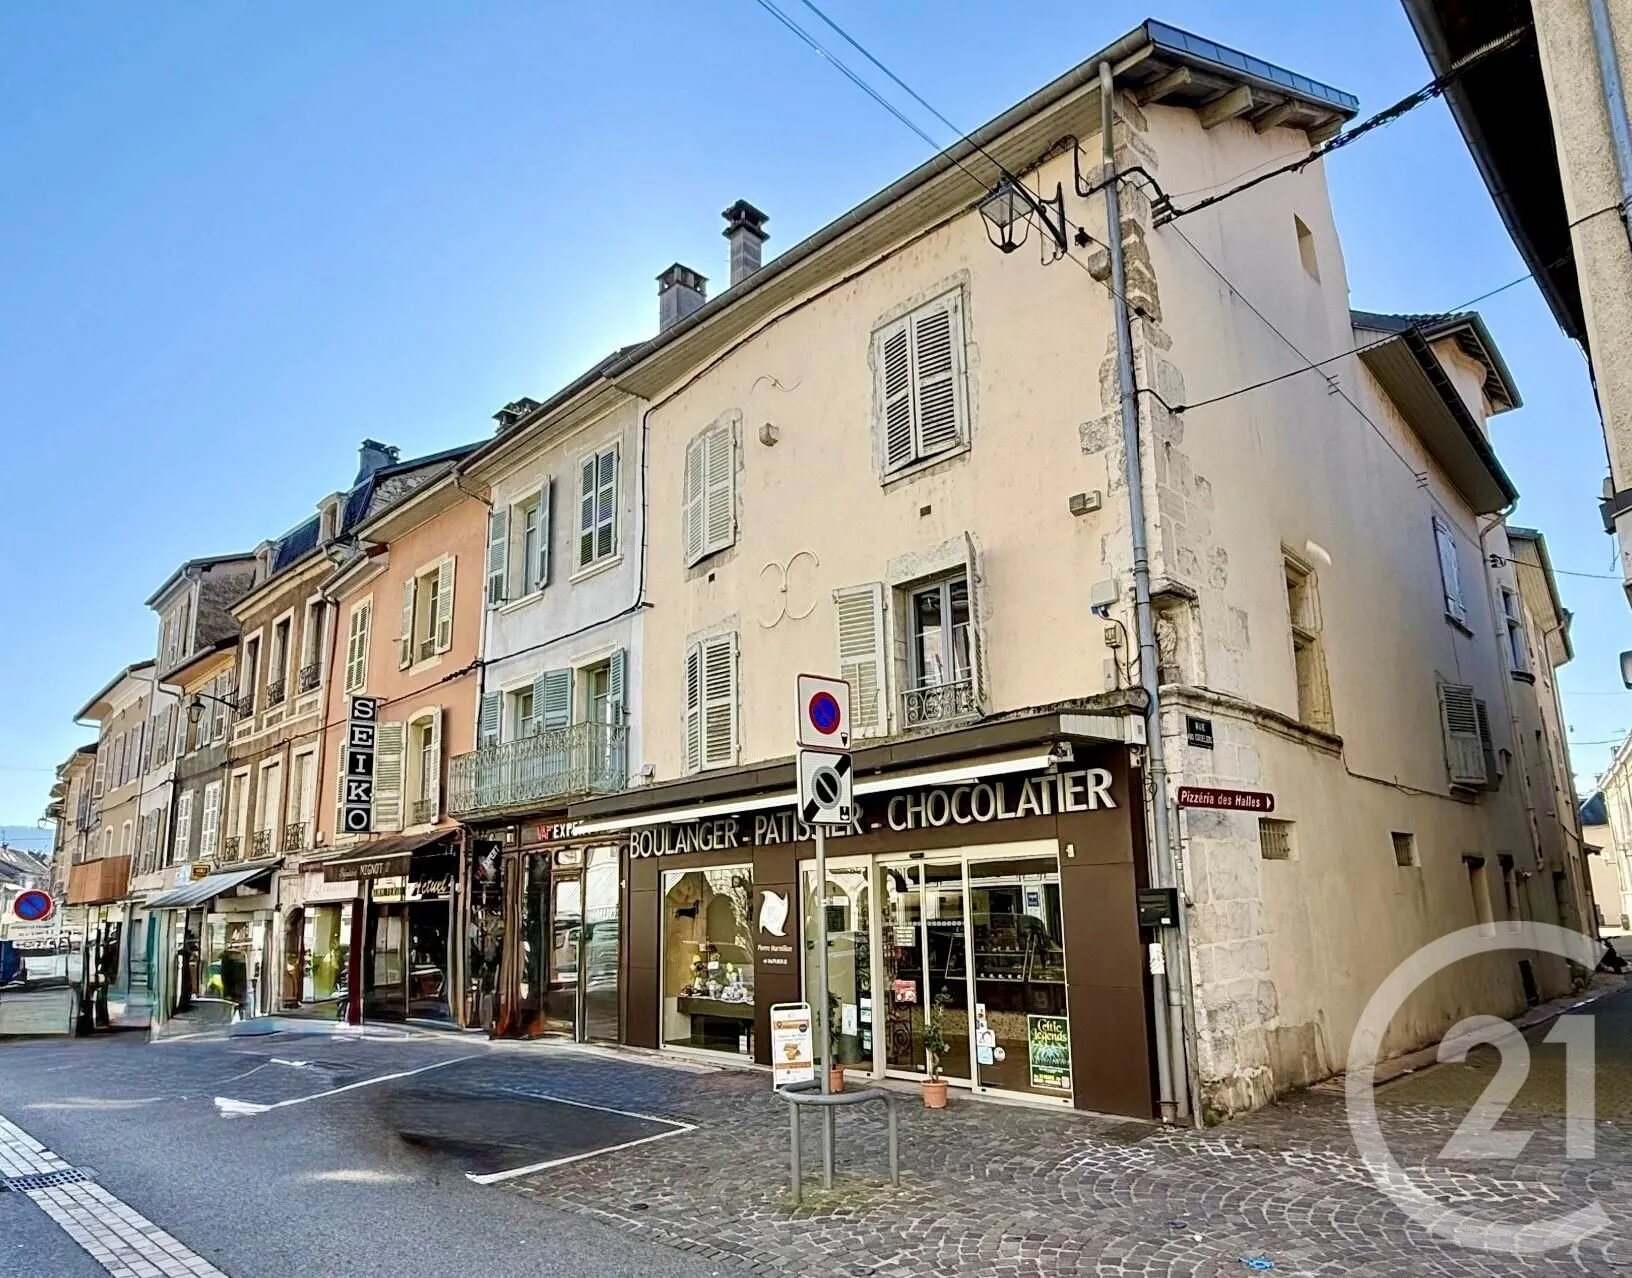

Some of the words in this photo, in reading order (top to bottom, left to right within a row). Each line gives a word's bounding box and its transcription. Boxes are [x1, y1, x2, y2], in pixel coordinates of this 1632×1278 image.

[347, 699, 374, 830] SEIKO
[1181, 790, 1214, 805] Pizzéria
[1217, 793, 1232, 805] des
[1235, 794, 1260, 808] Halles
[630, 818, 740, 859] BOULANGER
[755, 802, 864, 845] PATISR
[887, 767, 1118, 831] CHOCOLATIER
